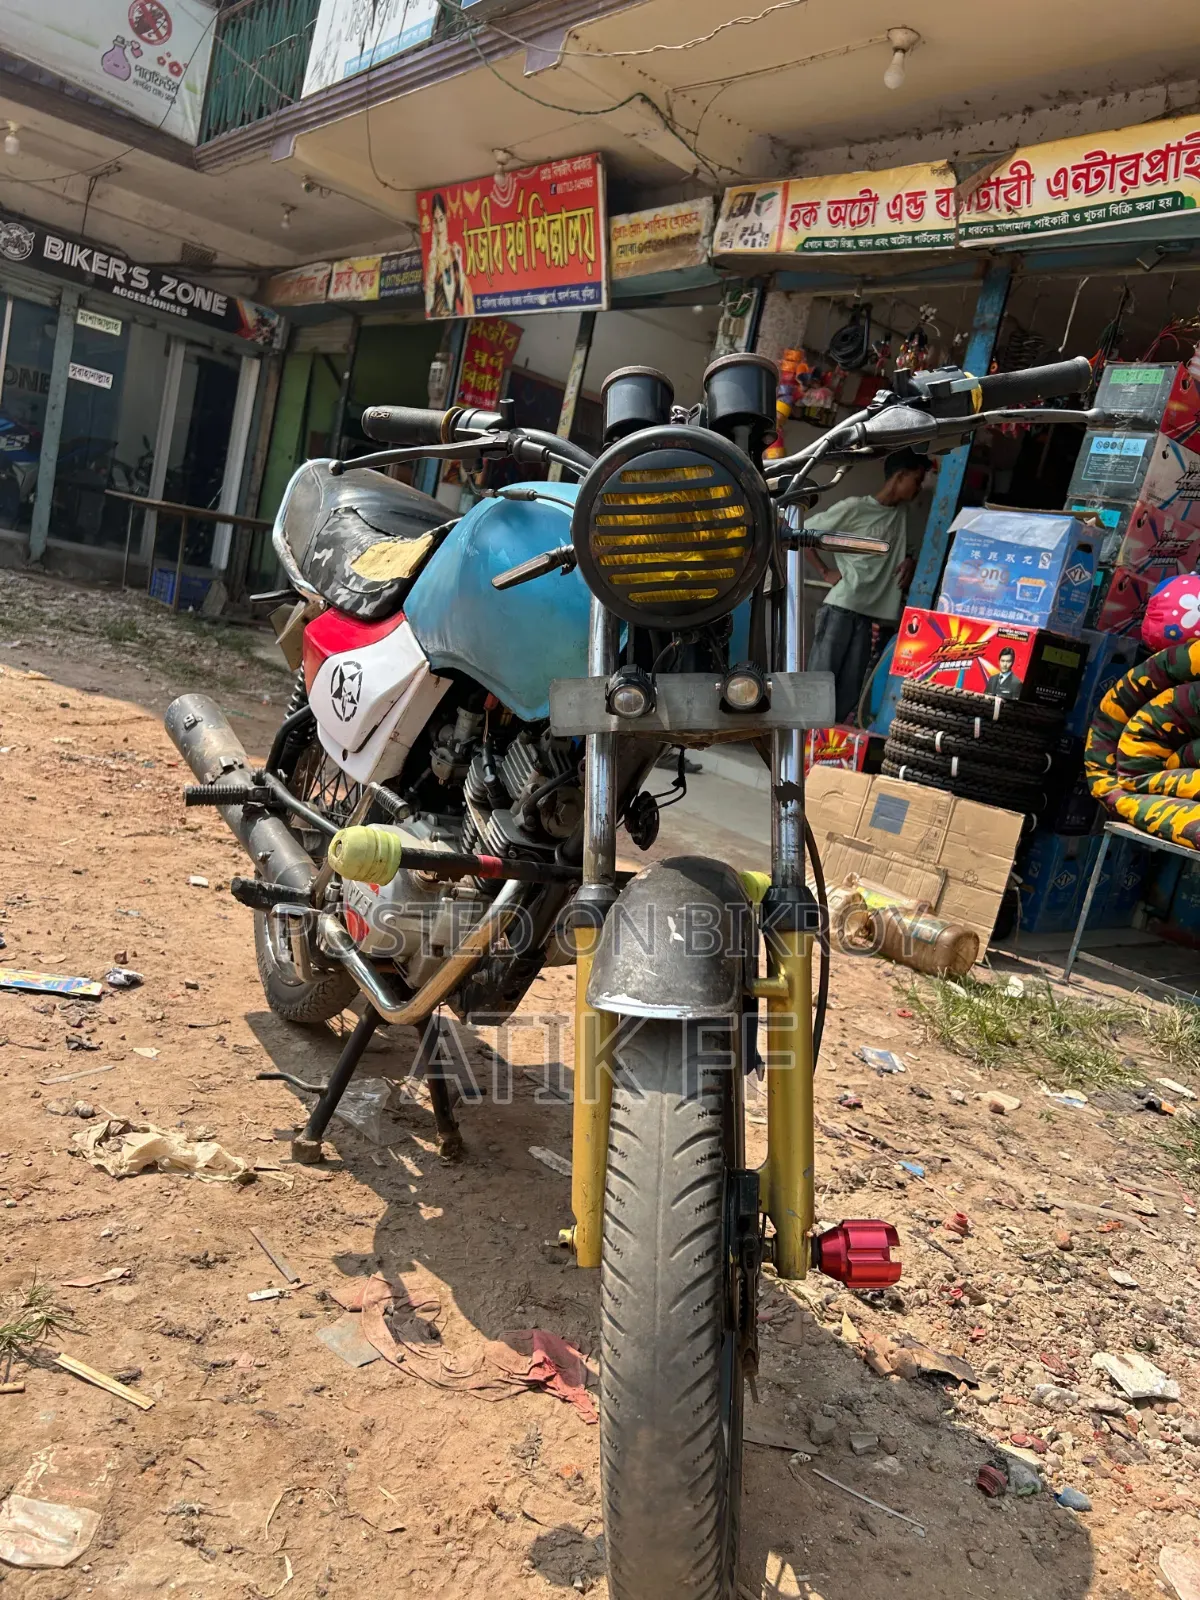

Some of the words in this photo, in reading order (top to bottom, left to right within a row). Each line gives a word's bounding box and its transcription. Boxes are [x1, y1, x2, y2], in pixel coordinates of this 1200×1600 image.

[788, 200, 821, 232] হক
[827, 188, 880, 229] অটো
[886, 190, 927, 222] এন্ড
[823, 238, 839, 249] অটো
[874, 237, 889, 248] এবং
[890, 233, 913, 245] অটোর
[968, 223, 995, 236] ধরনের
[996, 220, 1031, 234] মালামাল
[1033, 211, 1070, 229] পাইকারী
[1072, 212, 1081, 222] ও
[1083, 207, 1106, 223] খুচরা
[1109, 200, 1133, 217] বিক্রি
[1136, 199, 1155, 212] করা
[1158, 196, 1173, 209] হয়
[43, 235, 151, 290] BIKER'S
[159, 275, 228, 317] ZONE
